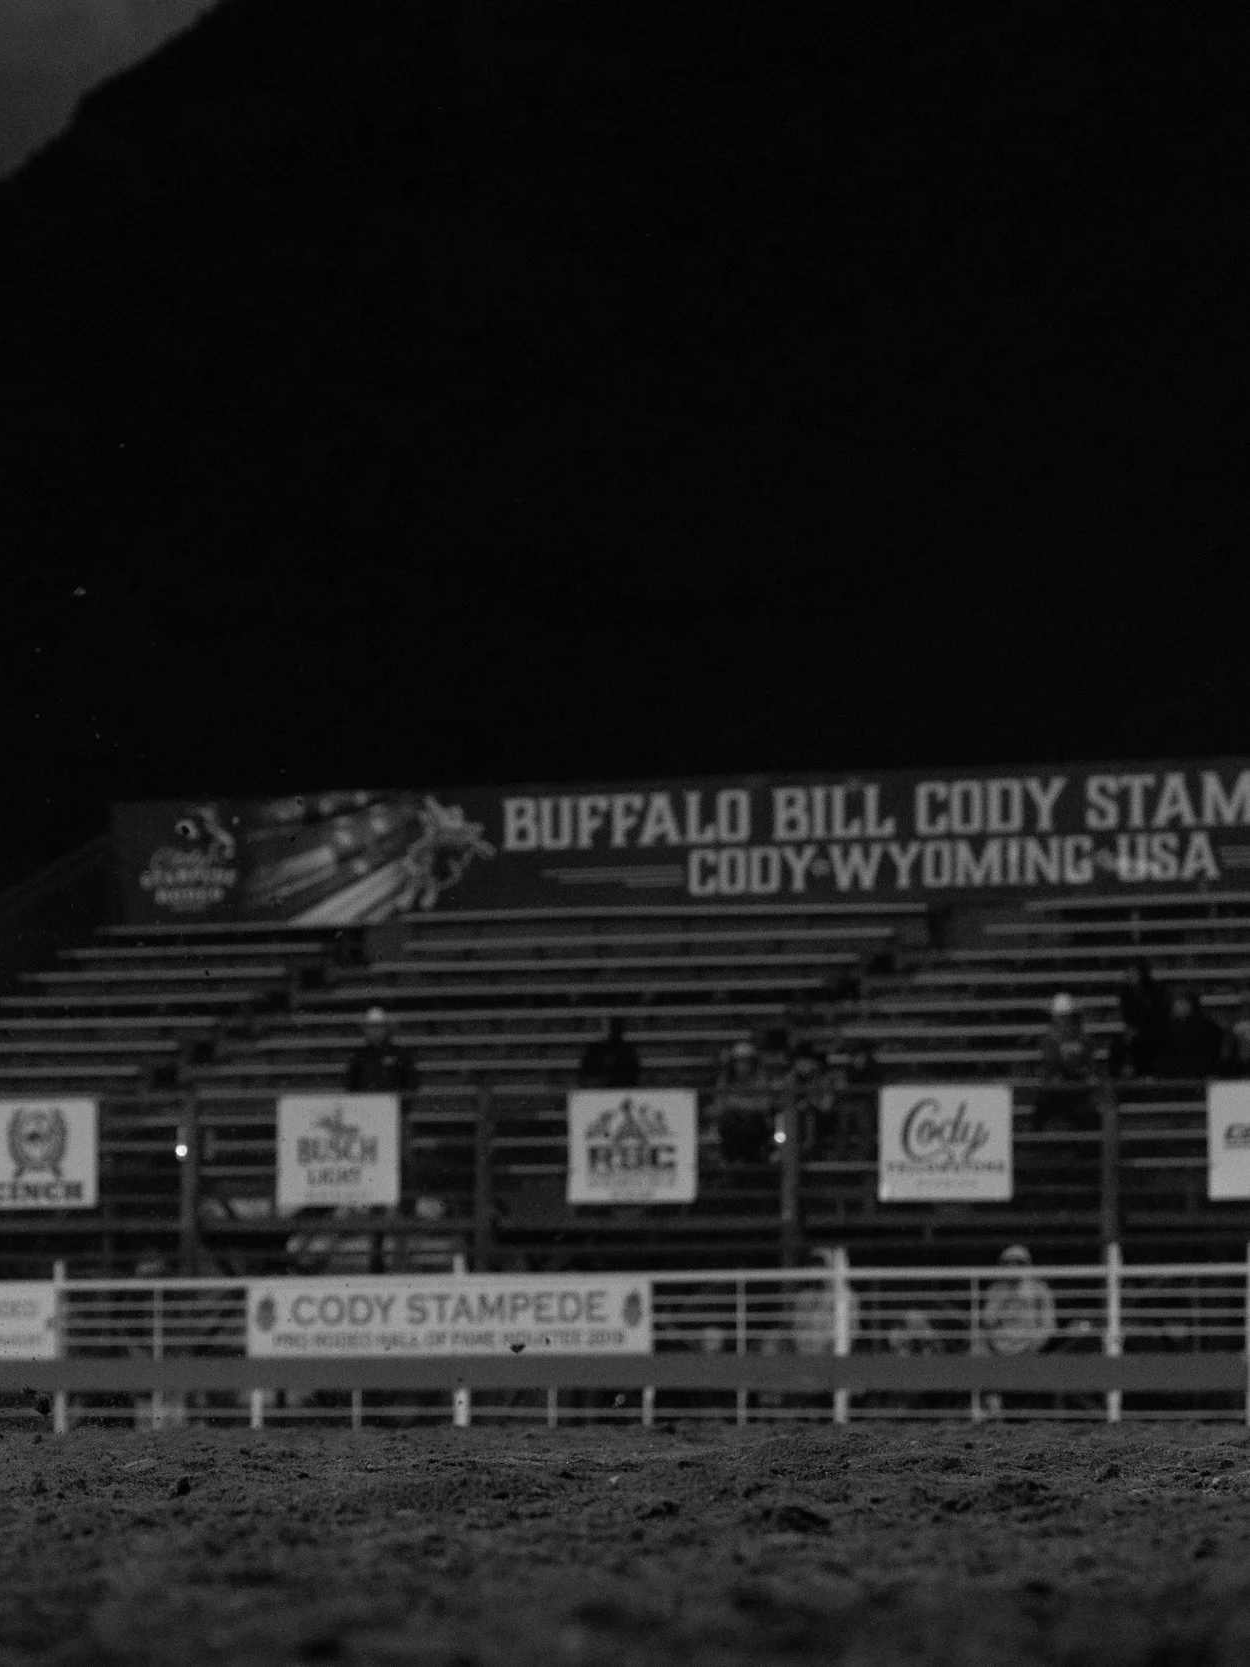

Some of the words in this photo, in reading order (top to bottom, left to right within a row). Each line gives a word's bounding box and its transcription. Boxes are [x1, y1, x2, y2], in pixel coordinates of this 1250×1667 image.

[503, 789, 751, 850] BUFFALO
[772, 783, 896, 841] BILL
[915, 776, 1067, 836] CODY
[1086, 770, 1250, 831] STAM
[688, 845, 817, 896] CODY
[829, 835, 1093, 889] WYOMING
[1116, 830, 1221, 882] USA
[900, 1098, 990, 1164] Cody
[291, 1295, 396, 1325] CODY
[406, 1291, 607, 1324] STAMPEDE
